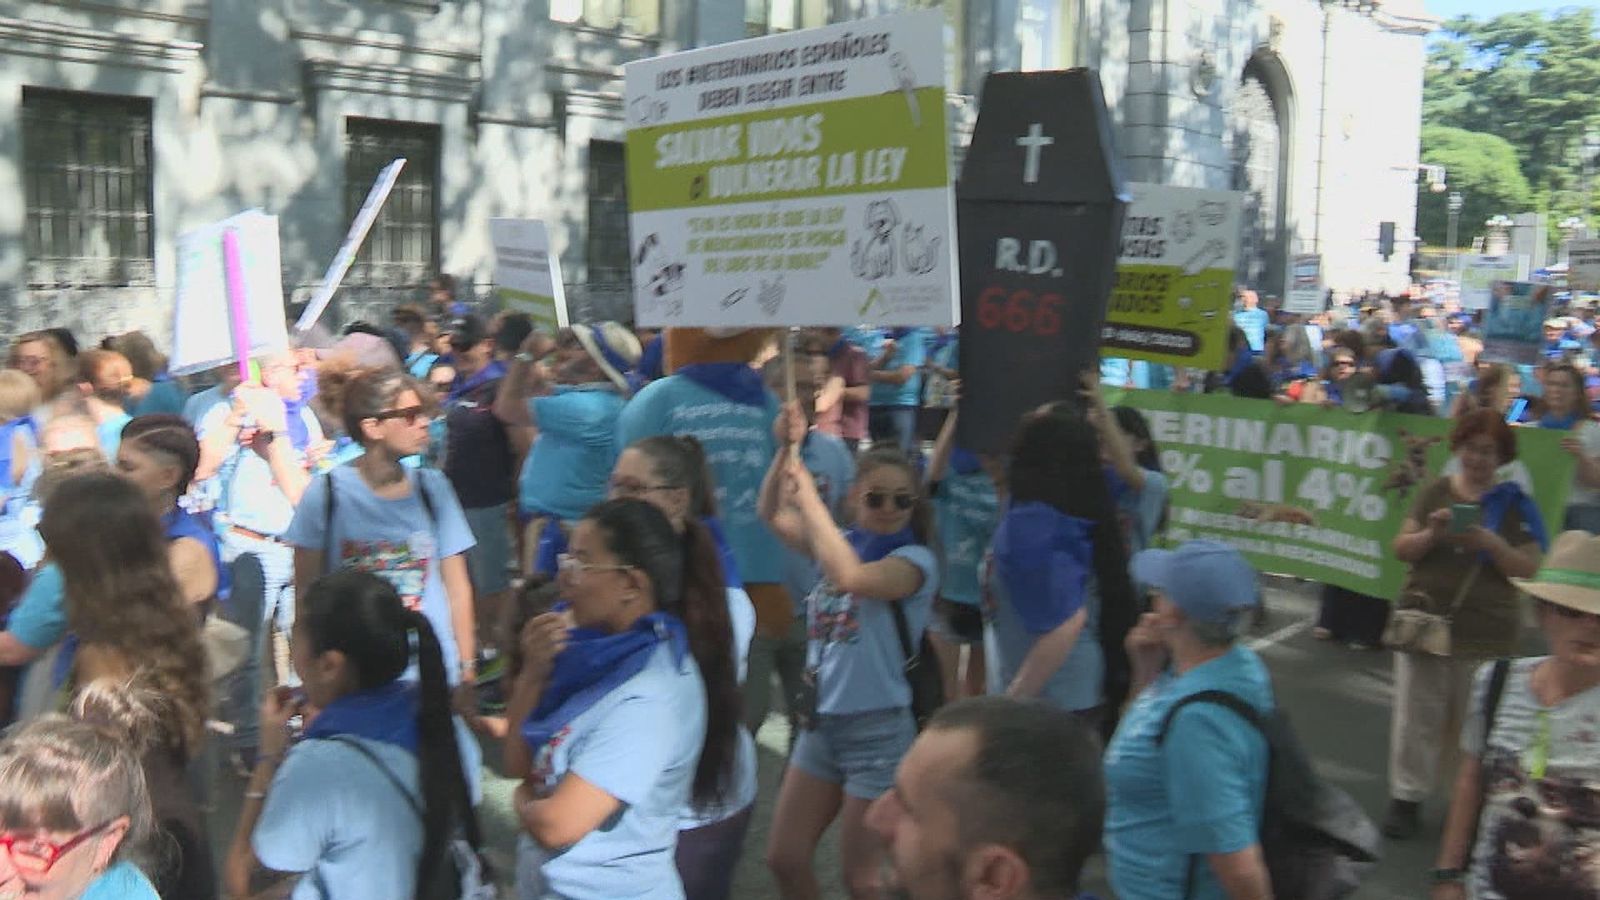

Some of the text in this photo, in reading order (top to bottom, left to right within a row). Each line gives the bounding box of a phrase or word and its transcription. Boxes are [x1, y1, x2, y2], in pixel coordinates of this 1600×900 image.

[656, 67, 683, 91] LOS
[800, 32, 891, 68] ESPAÑOLES
[799, 69, 848, 97] ENTRE
[655, 112, 825, 169] SALVAR VIDAS
[708, 155, 822, 199] VULNERAR
[825, 150, 857, 188] LA
[861, 147, 909, 186] LEY
[1124, 214, 1164, 236] TAS
[996, 237, 1064, 278] R.D.
[976, 285, 1066, 336] 666
[1143, 408, 1393, 470] ERINARIO
[1222, 459, 1286, 504] al
[1296, 467, 1388, 522] 4%
